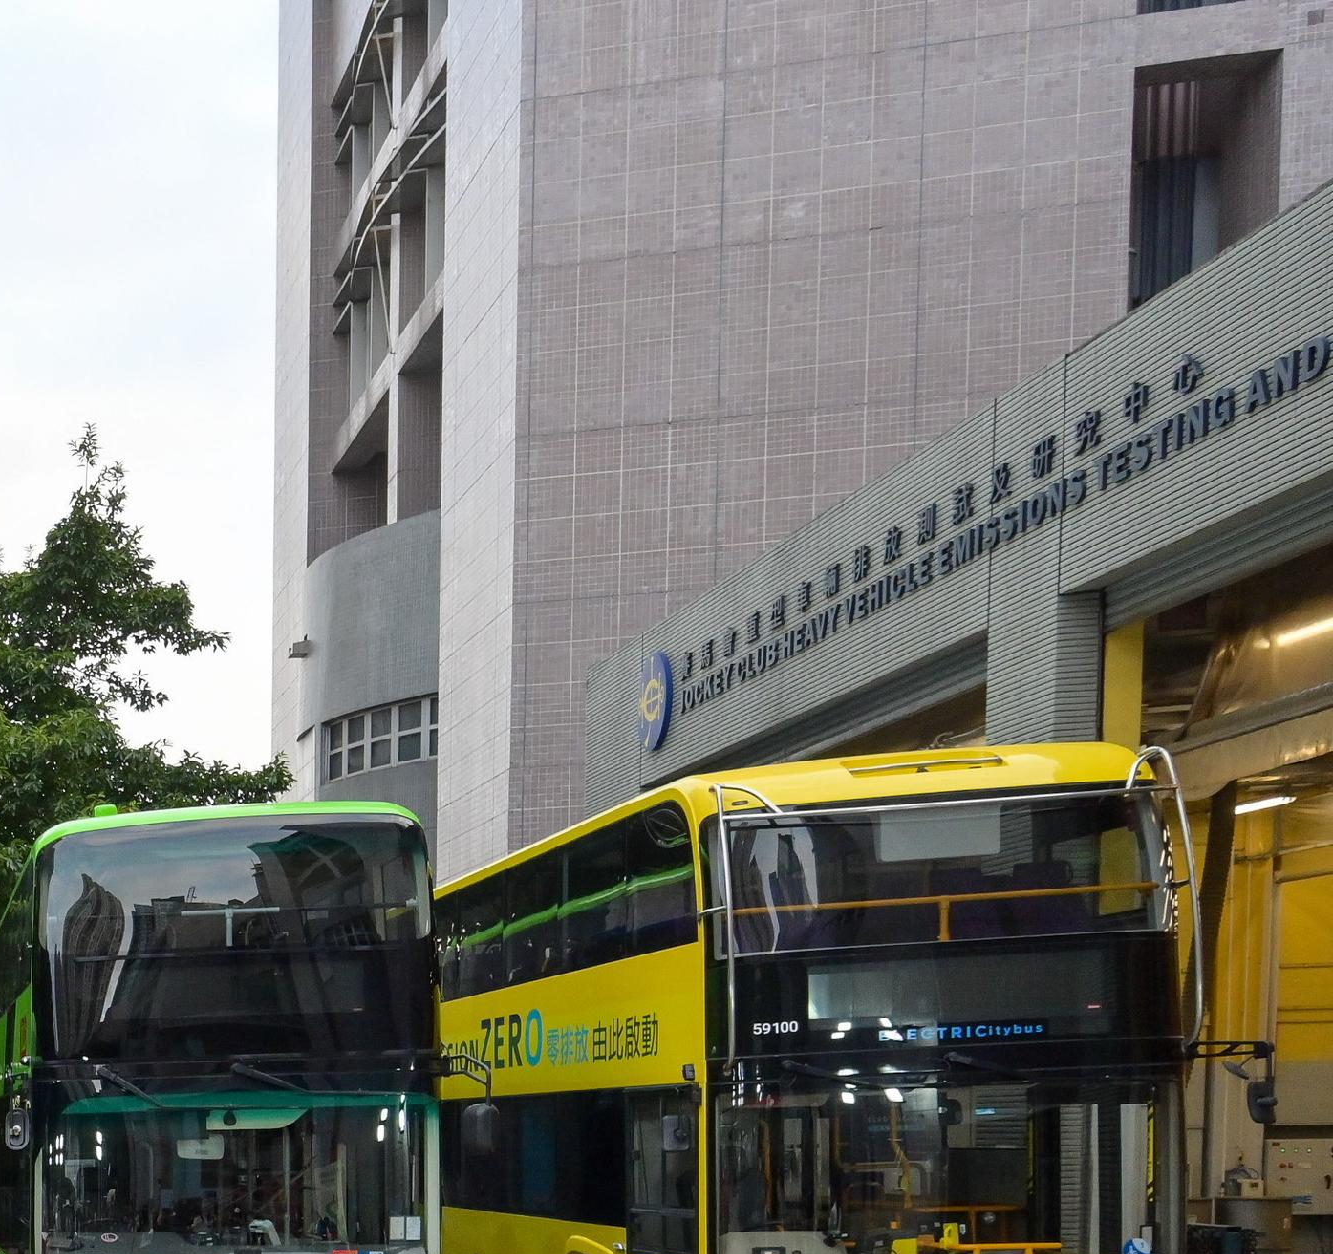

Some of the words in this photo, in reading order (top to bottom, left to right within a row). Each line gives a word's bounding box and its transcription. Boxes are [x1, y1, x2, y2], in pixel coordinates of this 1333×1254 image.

[681, 663, 736, 714] JOCKEY
[737, 641, 782, 683] CLUB
[782, 603, 842, 659] HEAVY
[845, 551, 934, 624] VEHICLE
[937, 469, 1087, 575] EMISSIONS
[1094, 387, 1236, 491] TESTING
[1244, 336, 1332, 414] AND
[481, 1008, 543, 1071] ZERO
[546, 1024, 590, 1066] 零排放
[753, 1020, 799, 1035] 59100
